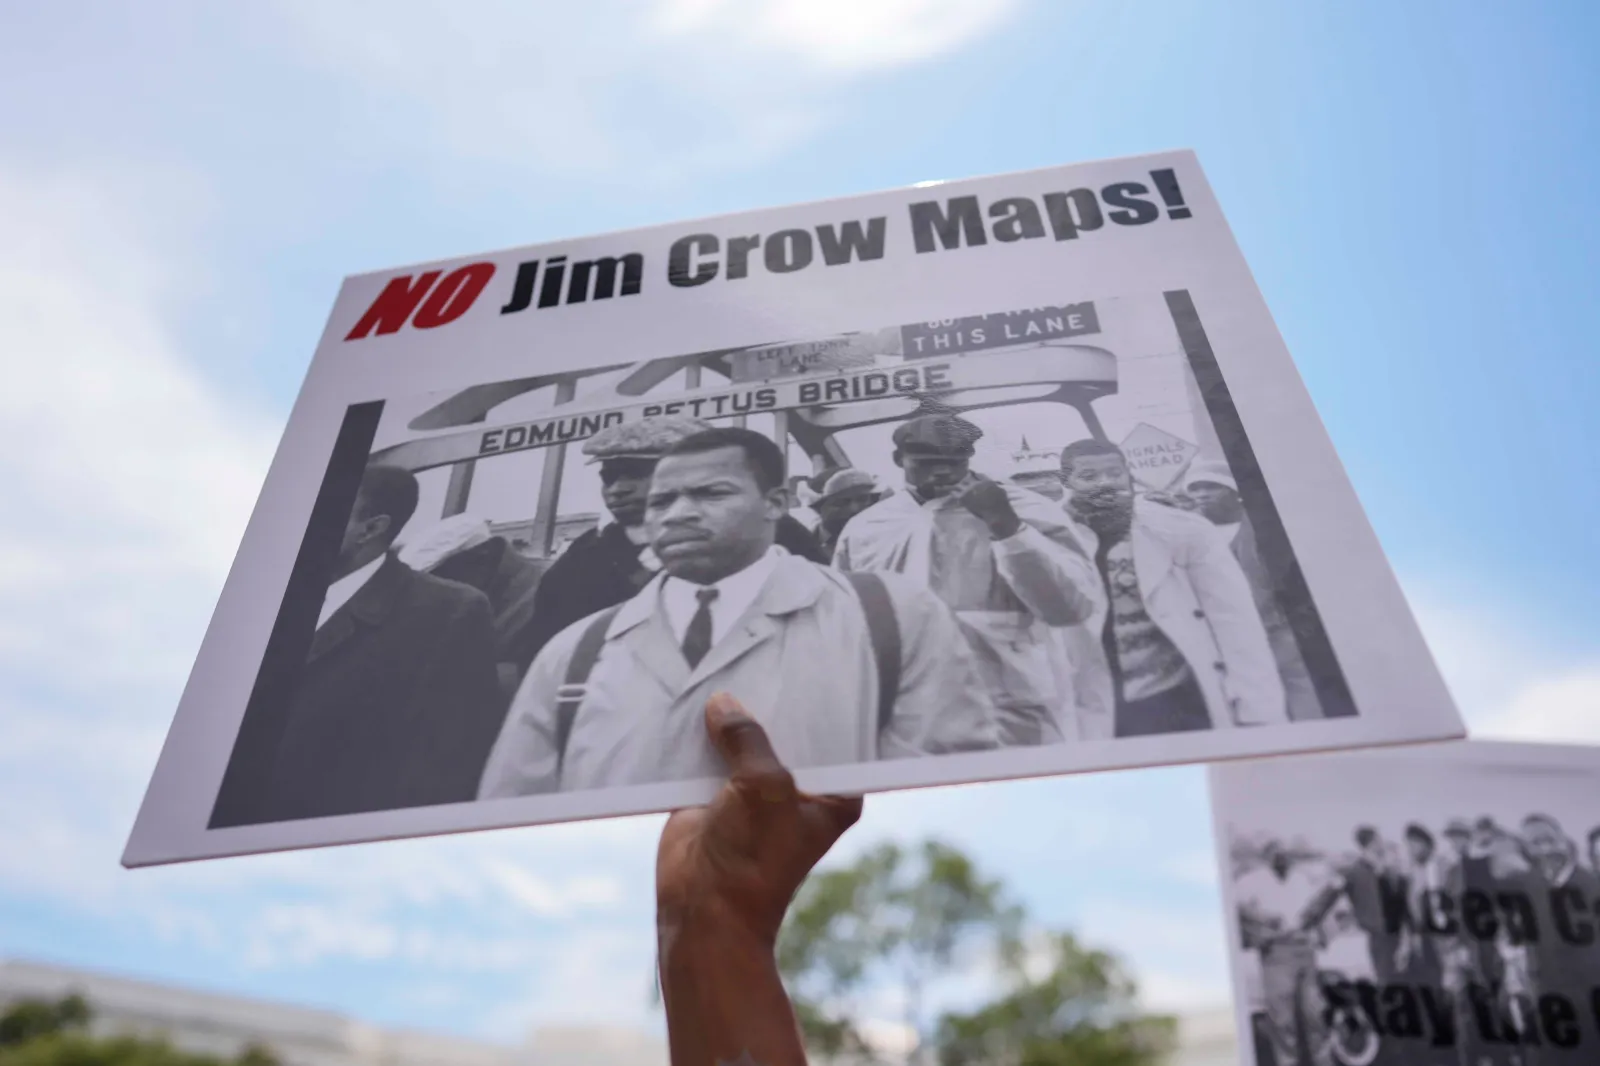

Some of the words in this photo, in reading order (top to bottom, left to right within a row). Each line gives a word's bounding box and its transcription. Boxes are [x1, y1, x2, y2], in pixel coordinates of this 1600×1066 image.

[343, 262, 497, 341] NO
[500, 252, 644, 315] Jim
[668, 216, 887, 287] Crow
[909, 168, 1193, 253] Maps!
[913, 328, 986, 352] THIS
[1004, 314, 1085, 339] LANE
[799, 363, 953, 404] BRIDGE
